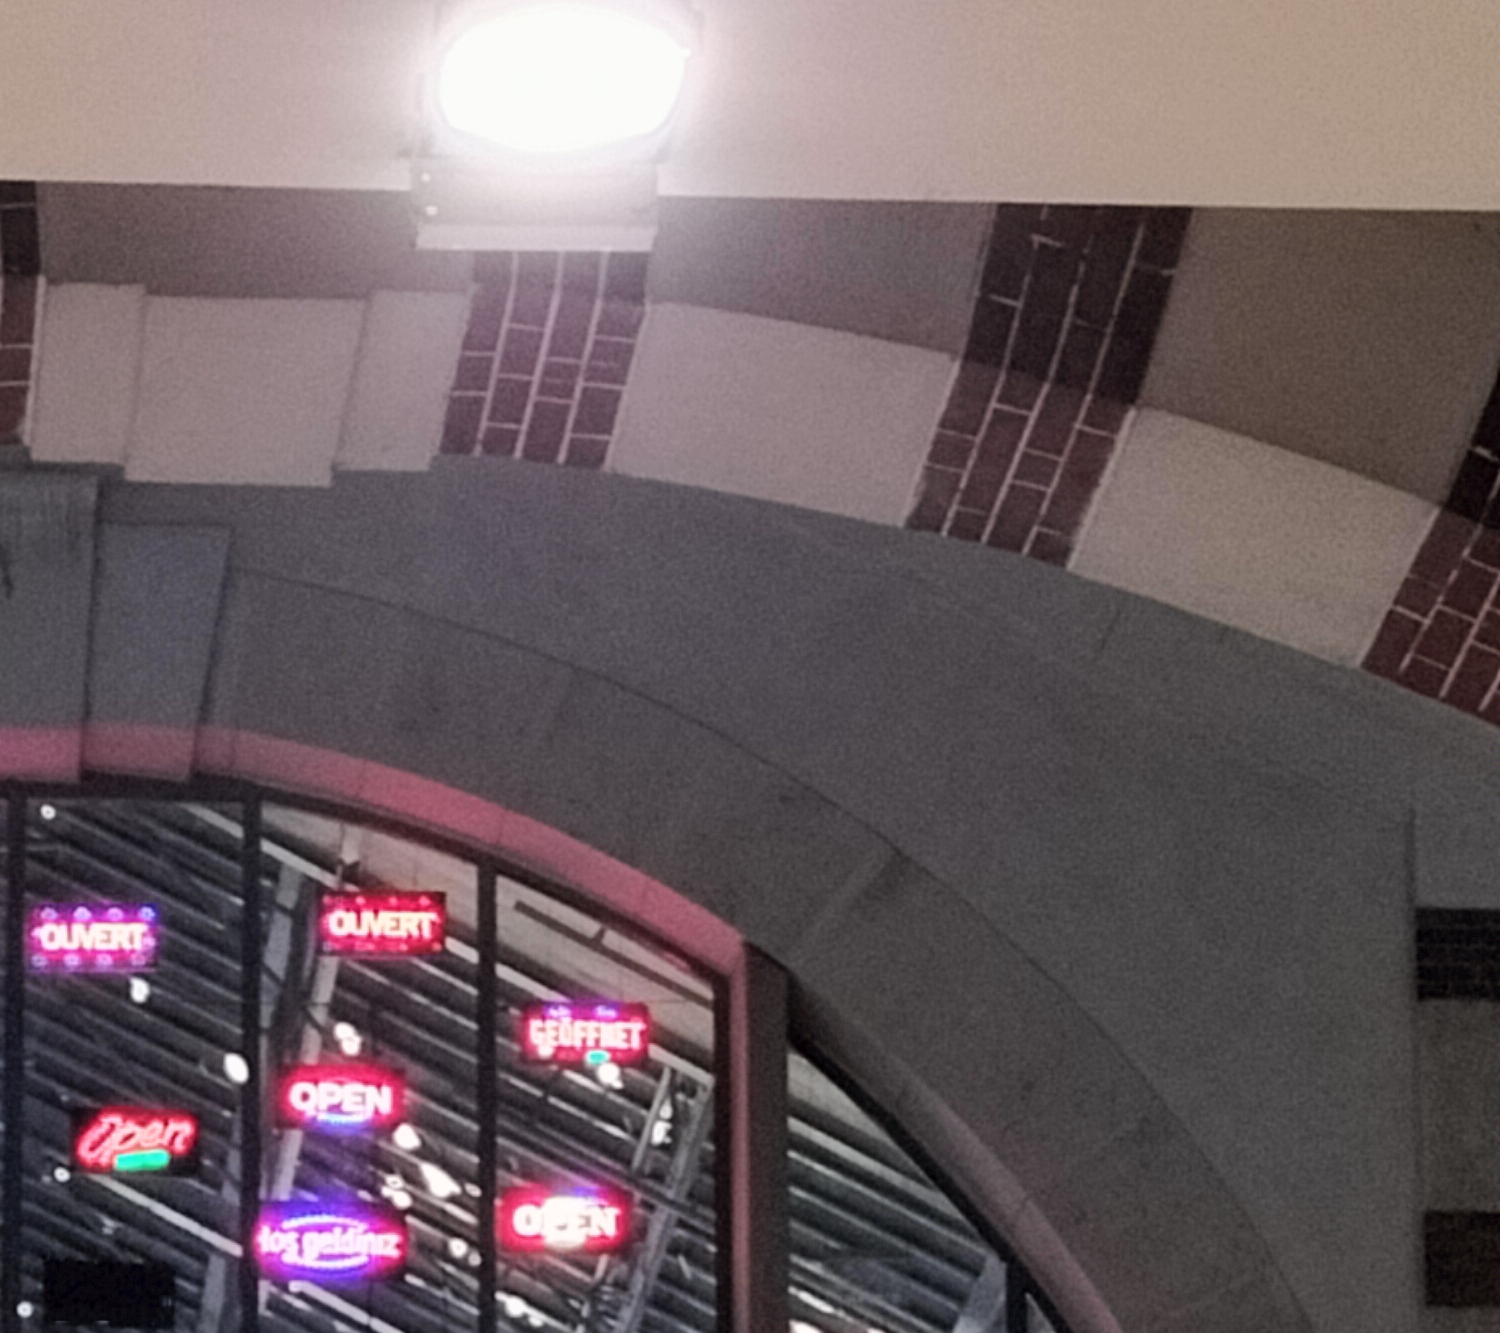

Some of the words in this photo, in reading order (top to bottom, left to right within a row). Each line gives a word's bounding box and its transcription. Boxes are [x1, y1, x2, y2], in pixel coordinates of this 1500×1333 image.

[40, 922, 147, 951] OUVERT
[329, 910, 440, 939] OUVERT
[289, 1082, 393, 1118] OPEN
[77, 1114, 194, 1167] Open
[512, 1203, 620, 1238] OPEN
